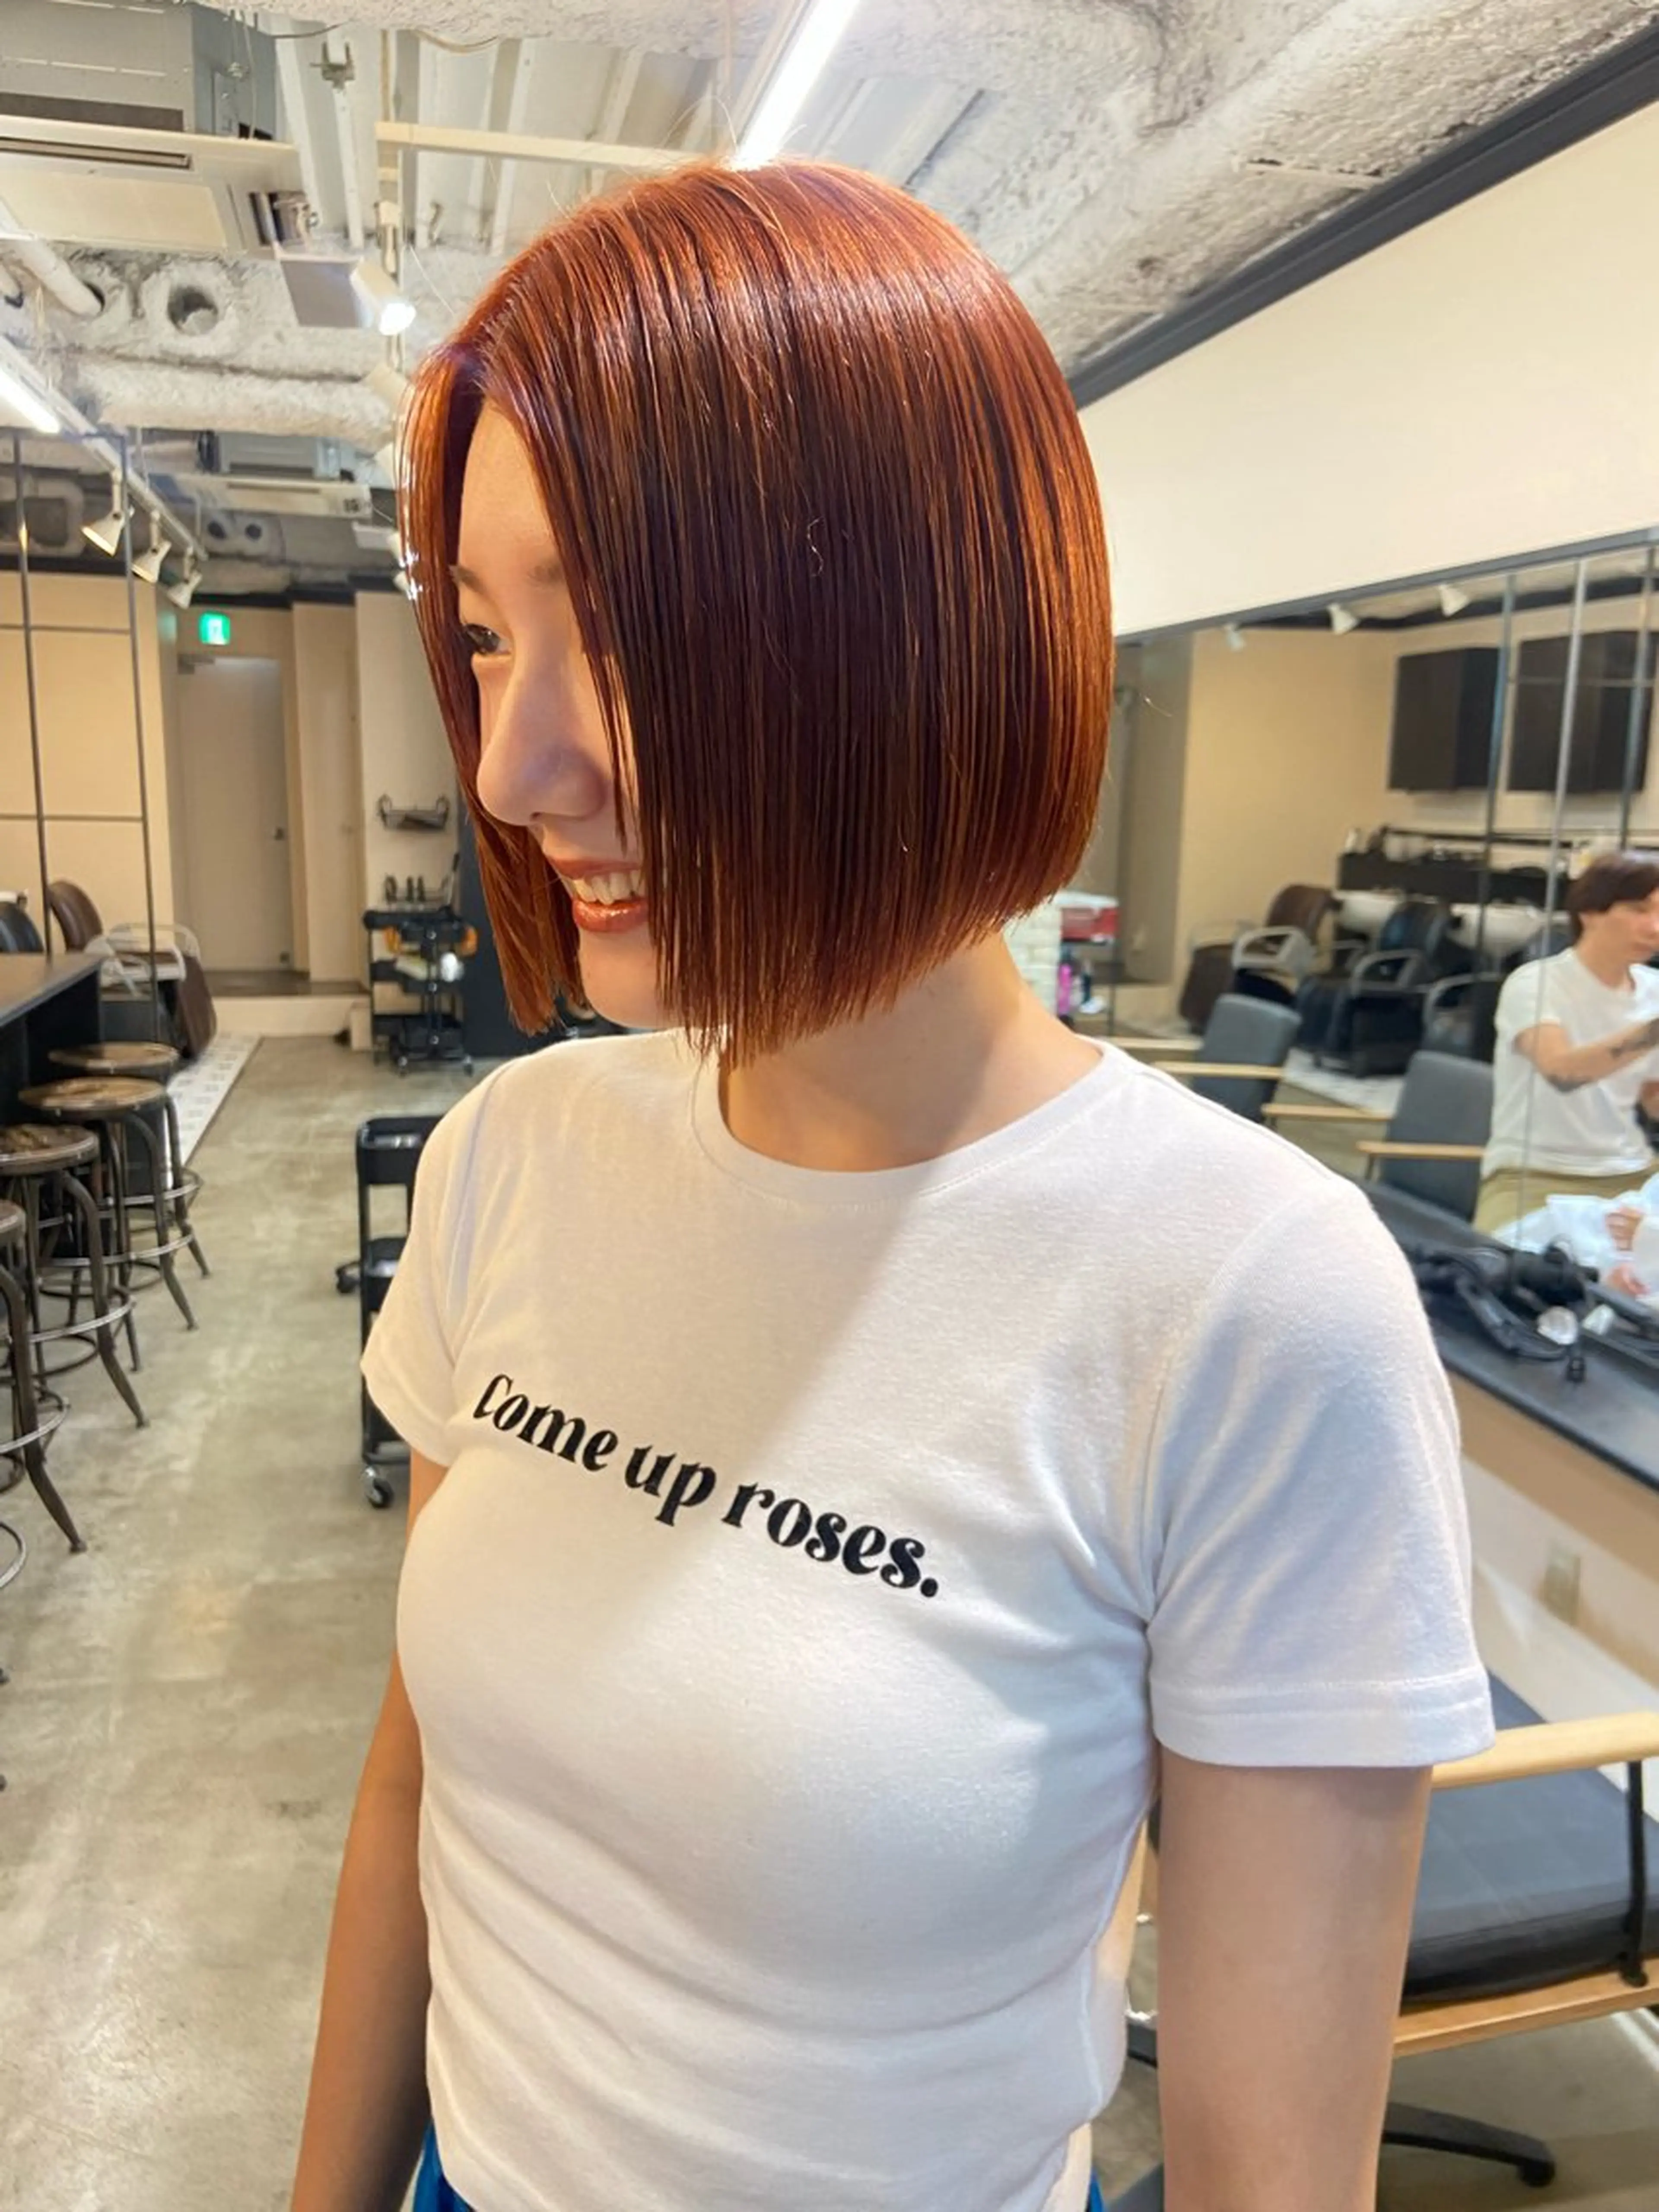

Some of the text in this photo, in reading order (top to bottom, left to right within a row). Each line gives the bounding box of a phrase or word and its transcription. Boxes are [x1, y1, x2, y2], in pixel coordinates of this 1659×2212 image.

[473, 1374, 938, 1598] Come up roses.
